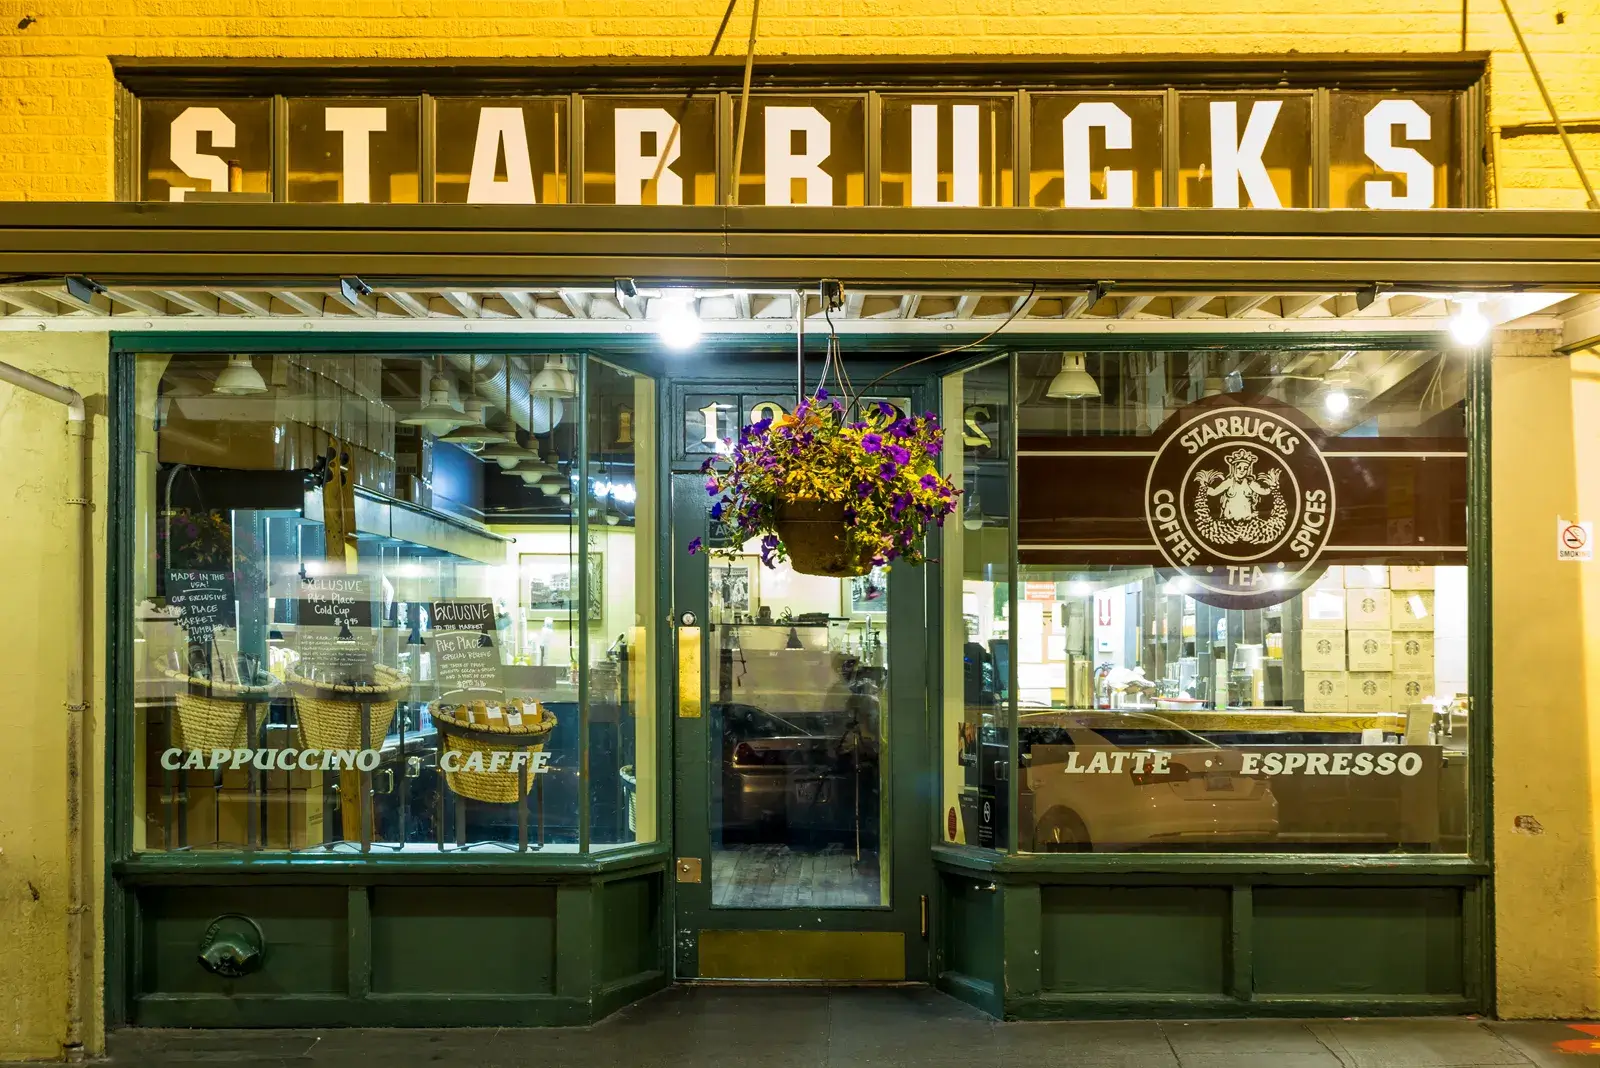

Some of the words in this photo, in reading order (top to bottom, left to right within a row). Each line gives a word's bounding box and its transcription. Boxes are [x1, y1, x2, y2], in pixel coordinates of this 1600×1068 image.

[169, 99, 1437, 212] STARBUCKS
[1180, 415, 1300, 455] STARBUCKS
[1153, 489, 1201, 568] COFFEE
[1290, 489, 1327, 559] SPICES
[170, 572, 195, 582] MADE
[300, 578, 364, 592] EXCLUSIVE
[1226, 565, 1269, 587] TEA
[171, 595, 188, 603] OUR
[188, 593, 228, 602] EXCLUSIVE
[331, 592, 356, 605] Place
[191, 604, 219, 615] PLACE
[314, 605, 333, 615] Cold
[333, 605, 350, 618] Cup
[176, 614, 217, 627] MARKET
[160, 748, 381, 772] CAPPUCCINO
[439, 750, 552, 774] CAFFE
[1064, 751, 1172, 775] LATTE
[1239, 752, 1424, 777] ESPRESSO
